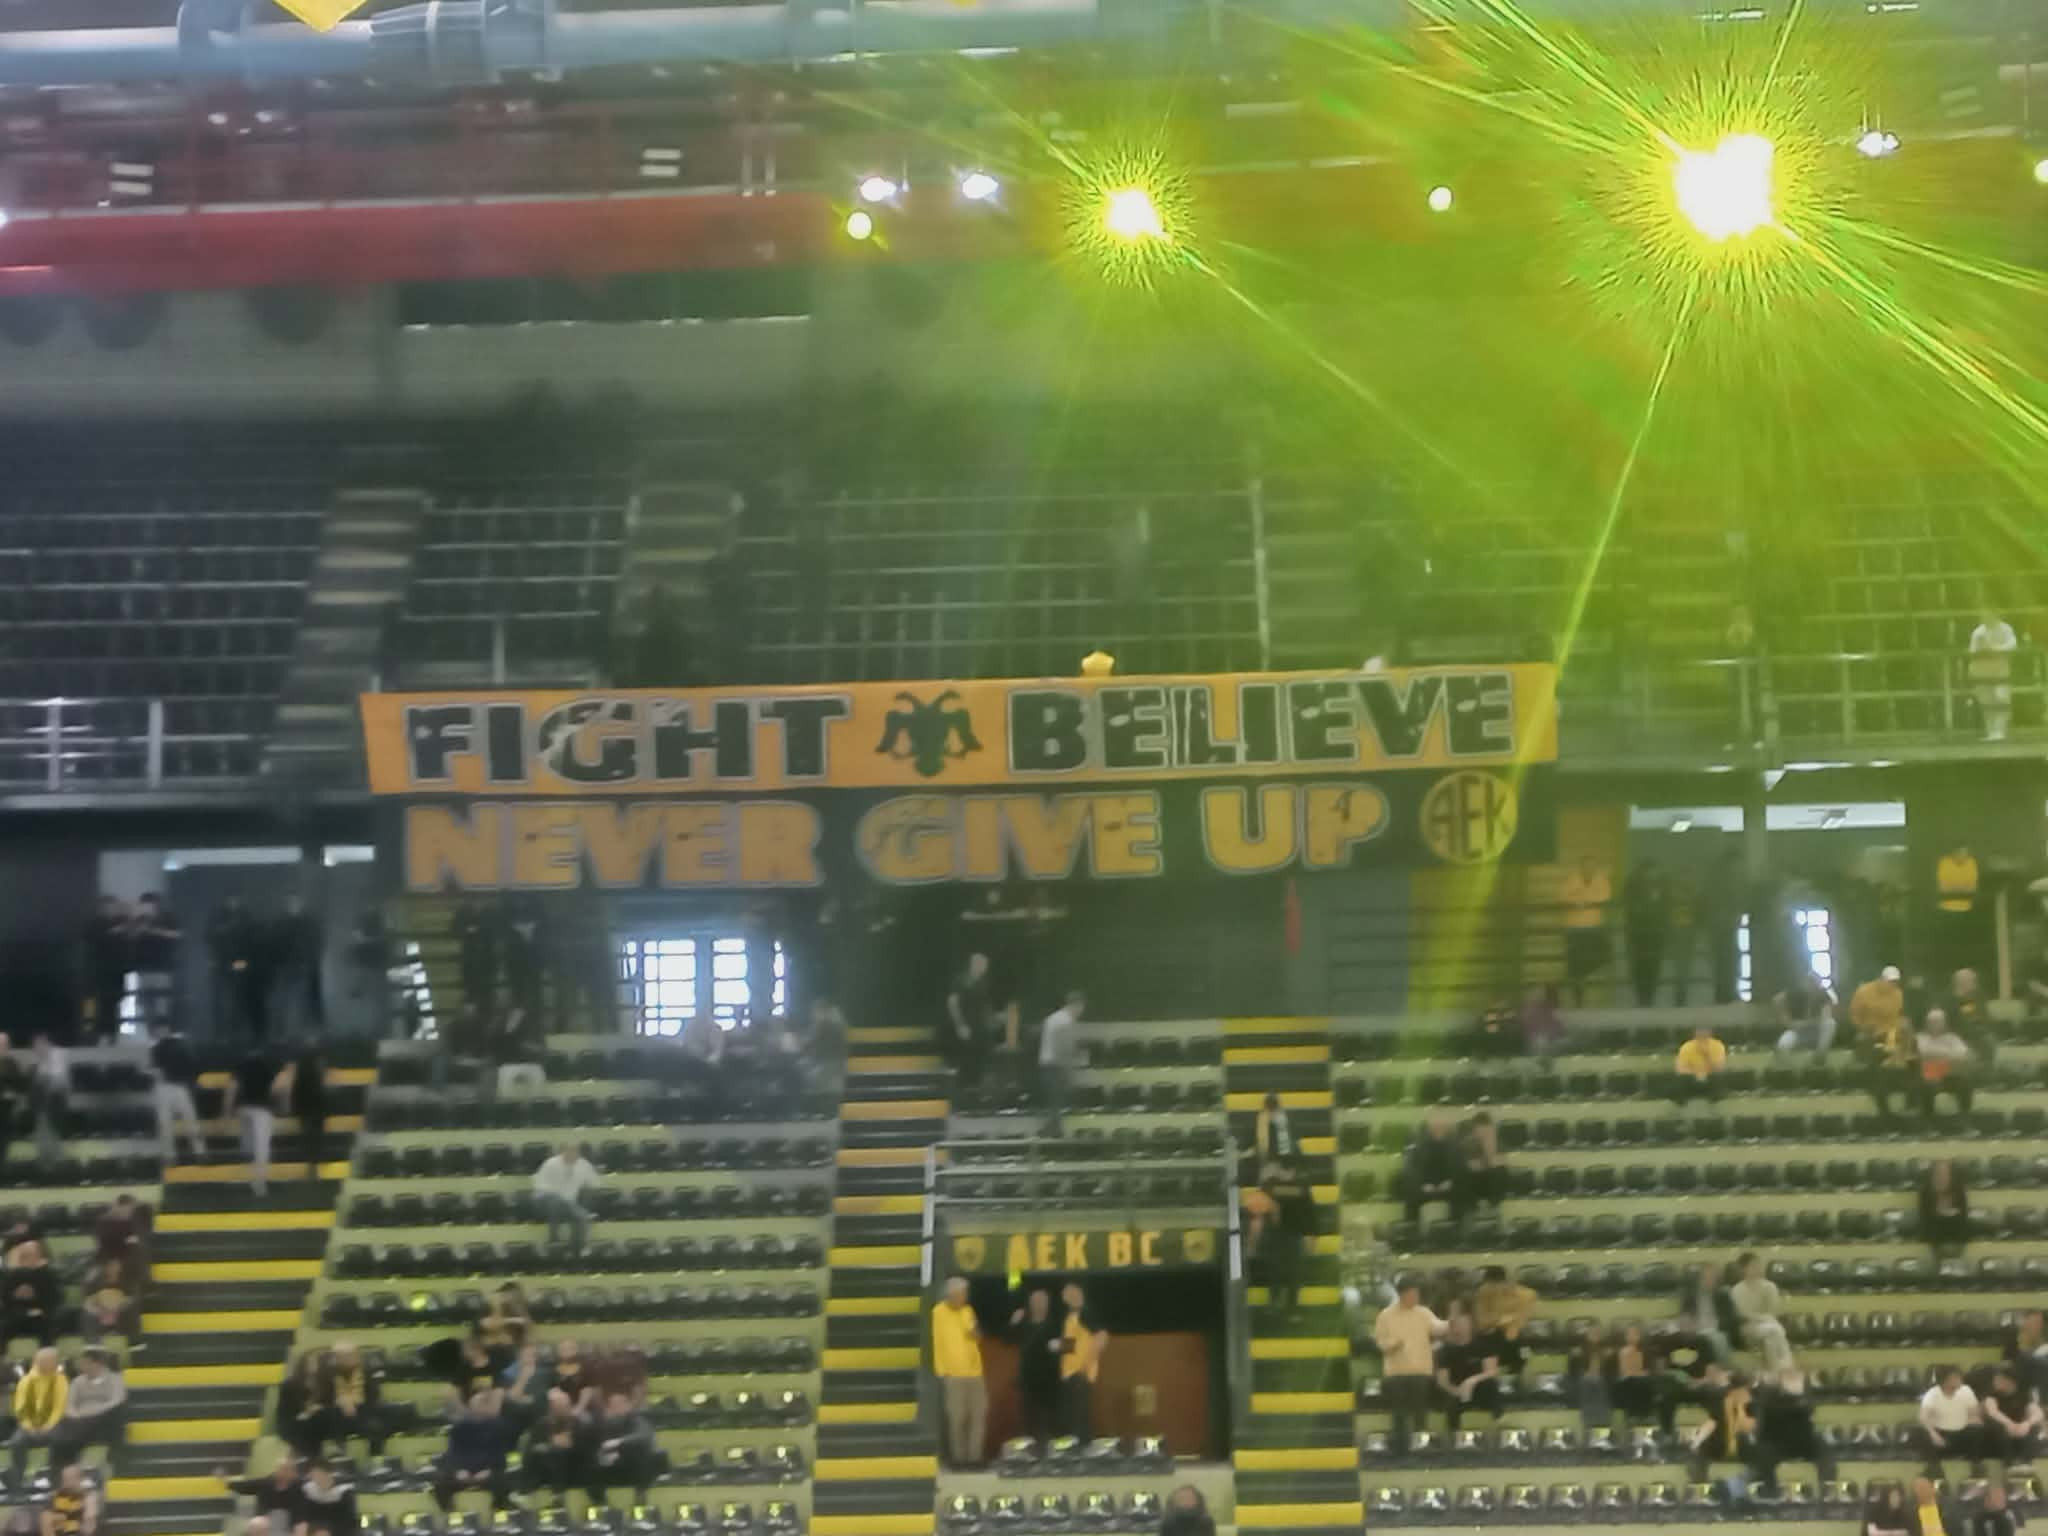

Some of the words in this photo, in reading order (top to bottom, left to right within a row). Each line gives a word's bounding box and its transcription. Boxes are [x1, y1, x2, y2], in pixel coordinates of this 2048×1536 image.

[406, 696, 851, 784] FIGHT
[1008, 672, 1514, 774] BELIEVE
[405, 801, 824, 891] NEVER
[856, 790, 1164, 887] GIVE
[1199, 782, 1390, 876] UP
[1427, 774, 1515, 861] AEK
[1008, 1231, 1089, 1270] AEK
[1108, 1231, 1163, 1267] BC
